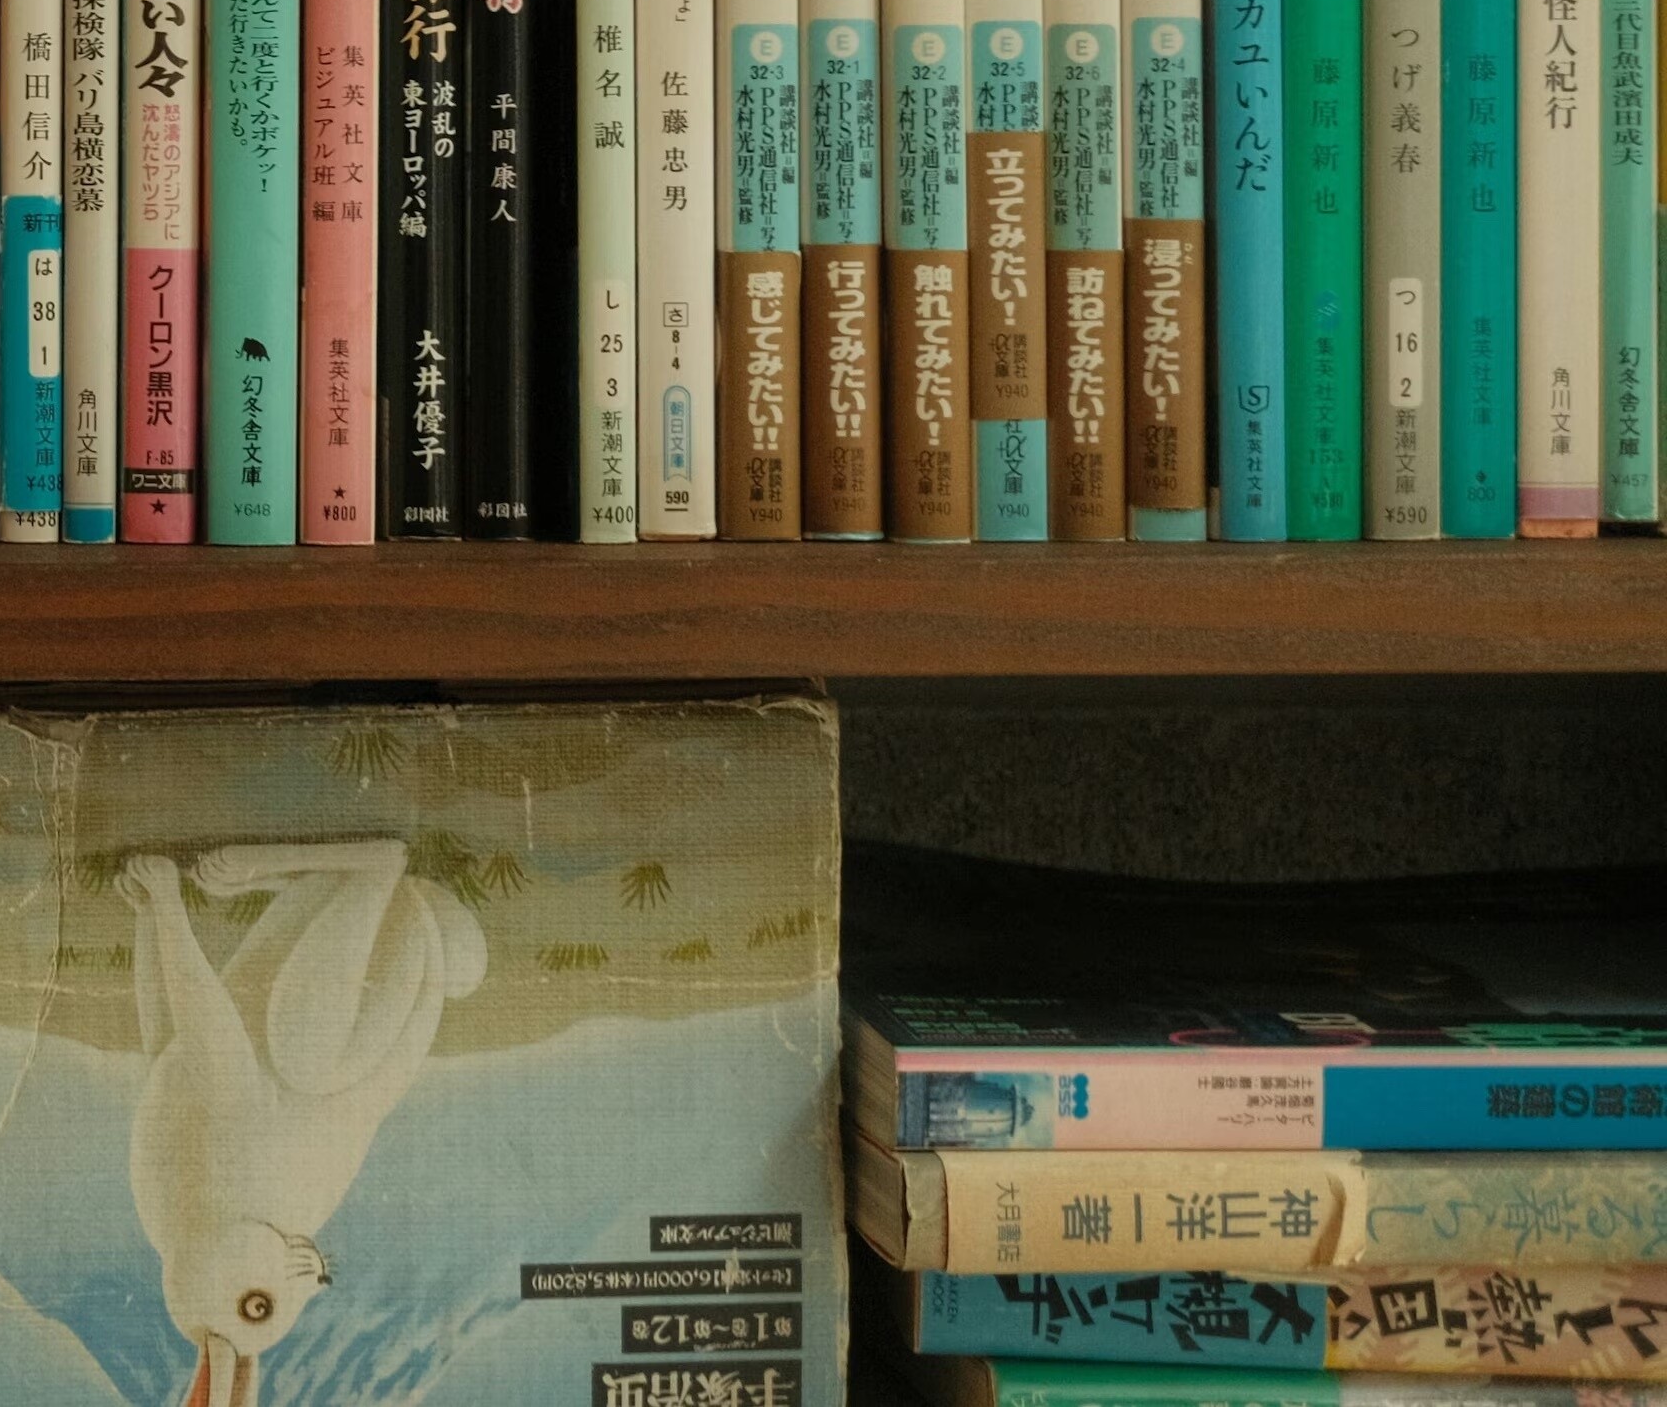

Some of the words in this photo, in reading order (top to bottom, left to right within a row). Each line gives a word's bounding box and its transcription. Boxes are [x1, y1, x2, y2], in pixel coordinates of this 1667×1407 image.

[20, 31, 53, 183] 橋田信介
[399, 78, 428, 240] 東ヨーロッパ編
[489, 91, 519, 225] 平間康人
[147, 264, 175, 427] クーロン黒沢
[412, 330, 447, 473] 大井優子
[130, 473, 188, 492] ワニ文庫
